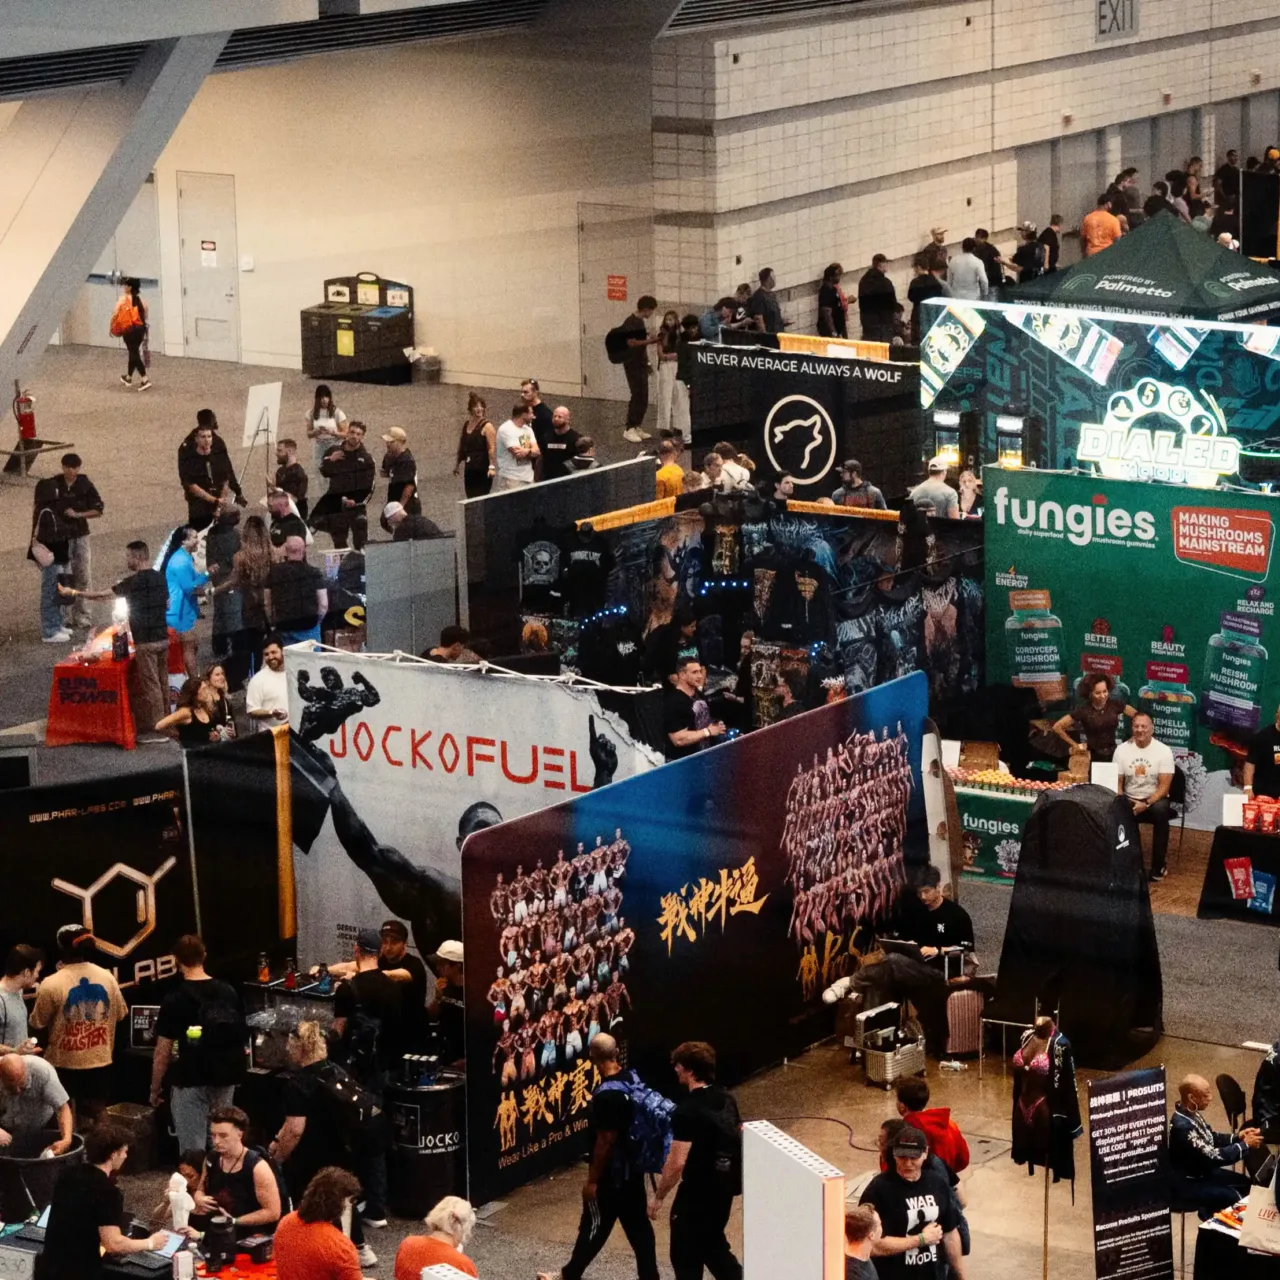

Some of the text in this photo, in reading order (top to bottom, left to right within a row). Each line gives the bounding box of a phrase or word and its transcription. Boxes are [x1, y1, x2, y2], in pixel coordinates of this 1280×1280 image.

[1099, 0, 1134, 35] EXIT
[1102, 274, 1143, 284] POWERED
[1094, 281, 1173, 298] Palmetto
[1068, 303, 1102, 312] SAVINGS
[1104, 306, 1125, 314] WITH
[697, 352, 902, 383] NEVER AVERAGE ALWAYS A WOLF
[1078, 424, 1240, 473] DIALED
[993, 487, 1156, 546] fungies
[1179, 511, 1230, 527] MAKING
[1179, 525, 1263, 544] MUSHROOMS
[1179, 538, 1265, 557] MAINSTREAM
[995, 578, 1028, 588] ENERGY
[1237, 599, 1259, 608] RELAX
[1237, 606, 1274, 616] RECHARGE
[1084, 633, 1118, 644] BETTER
[1151, 641, 1185, 652] BEAUTY
[1015, 646, 1058, 654] CORDYCEPS
[1015, 653, 1060, 662] MUSHROOM
[1221, 667, 1248, 679] REISHI
[1210, 673, 1258, 692] MUSHROOM
[1153, 718, 1186, 728] REMELLA
[329, 722, 593, 793] JOCKOFUEL
[963, 812, 1019, 835] fungies
[1128, 1083, 1164, 1099] PROSUITS
[1091, 1115, 1165, 1138] GET 30% OFF EVERYTHING
[419, 1131, 460, 1148] JOCKO
[1095, 1134, 1124, 1146] displayed
[1146, 1125, 1164, 1134] booth
[498, 1119, 589, 1170] Wear Like a Pro & Win
[1098, 1145, 1110, 1155] USE
[1111, 1142, 1127, 1152] CODE
[906, 1194, 936, 1210] WAR
[1257, 1208, 1278, 1220] LIVE
[905, 1253, 937, 1266] MODE
